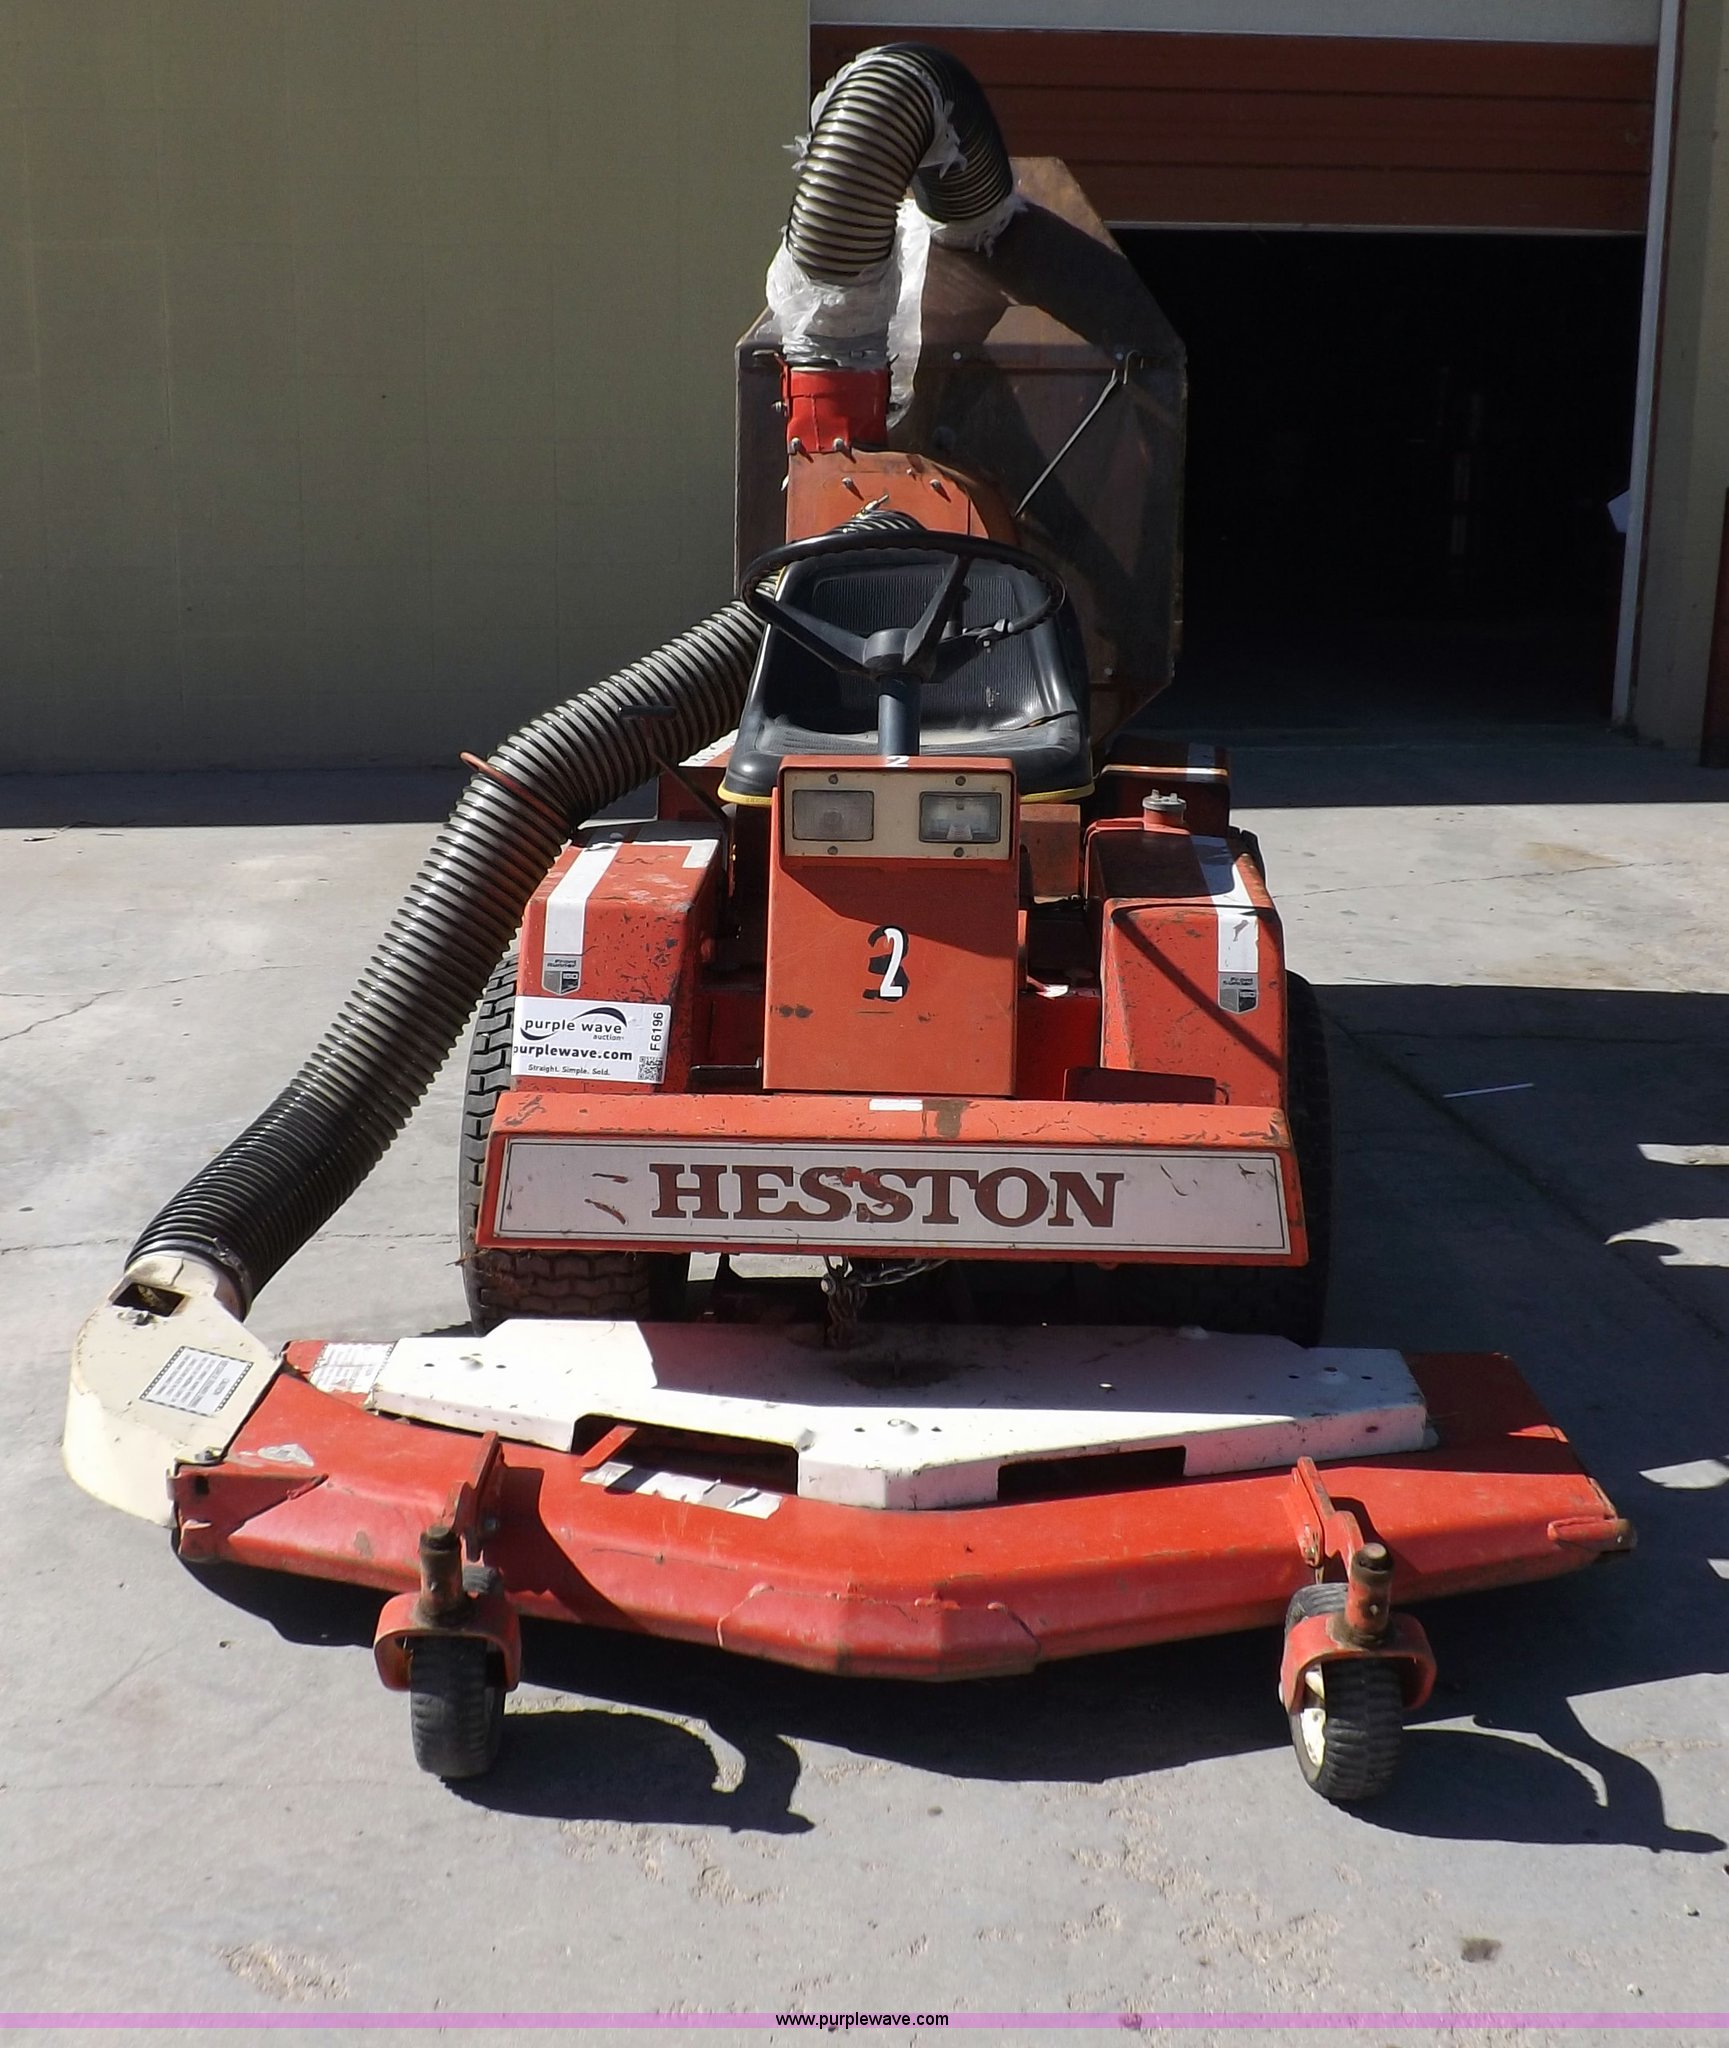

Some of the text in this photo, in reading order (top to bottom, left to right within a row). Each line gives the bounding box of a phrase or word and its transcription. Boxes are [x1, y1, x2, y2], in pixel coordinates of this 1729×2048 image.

[886, 755, 910, 768] 2
[879, 927, 904, 998] 2
[524, 1019, 622, 1034] purple wave
[649, 1011, 664, 1051] F6196
[527, 1063, 611, 1076] Straight. Simple. Sold.
[648, 1163, 1125, 1228] HESSTON
